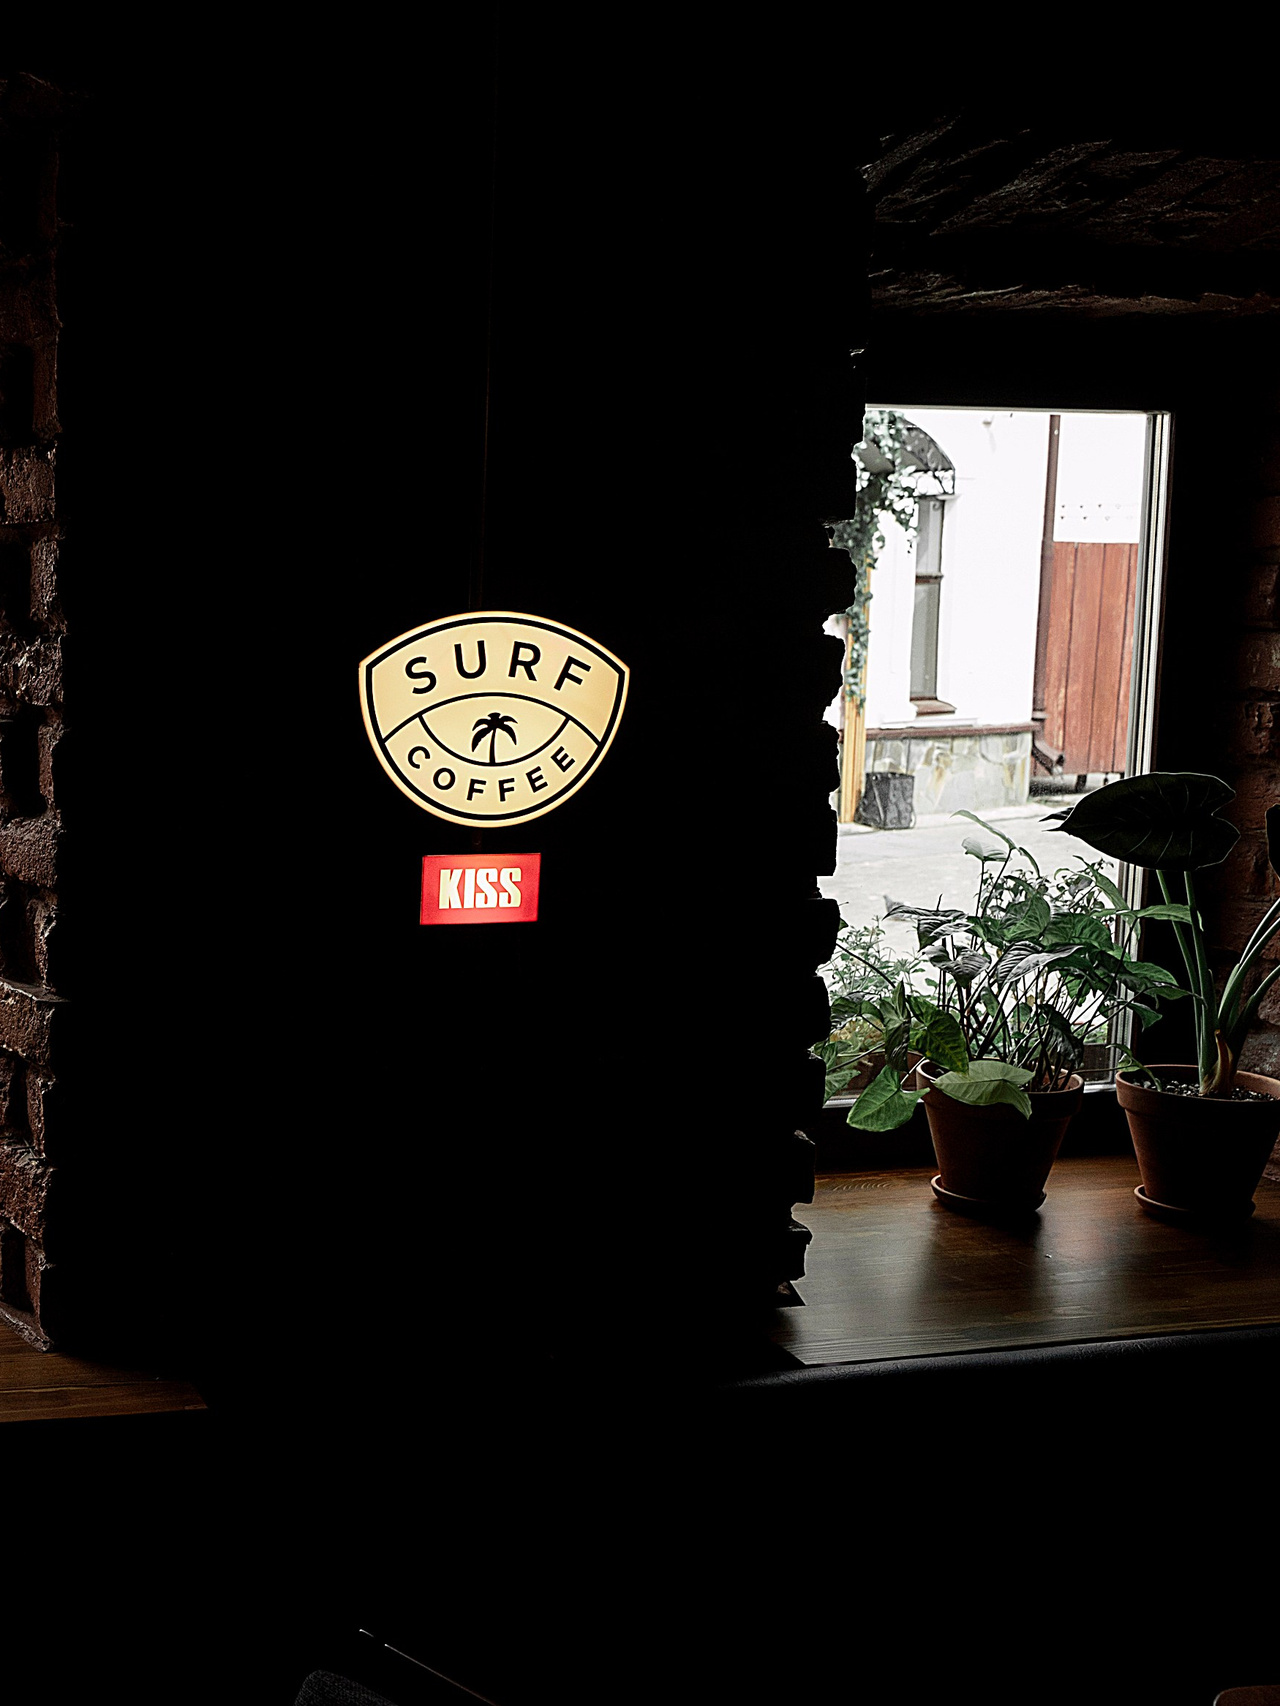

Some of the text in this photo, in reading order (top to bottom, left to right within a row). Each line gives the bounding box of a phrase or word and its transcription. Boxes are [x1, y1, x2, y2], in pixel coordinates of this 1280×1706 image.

[405, 640, 592, 694] SURF
[407, 745, 576, 802] COFFEE
[438, 868, 522, 909] KISS
